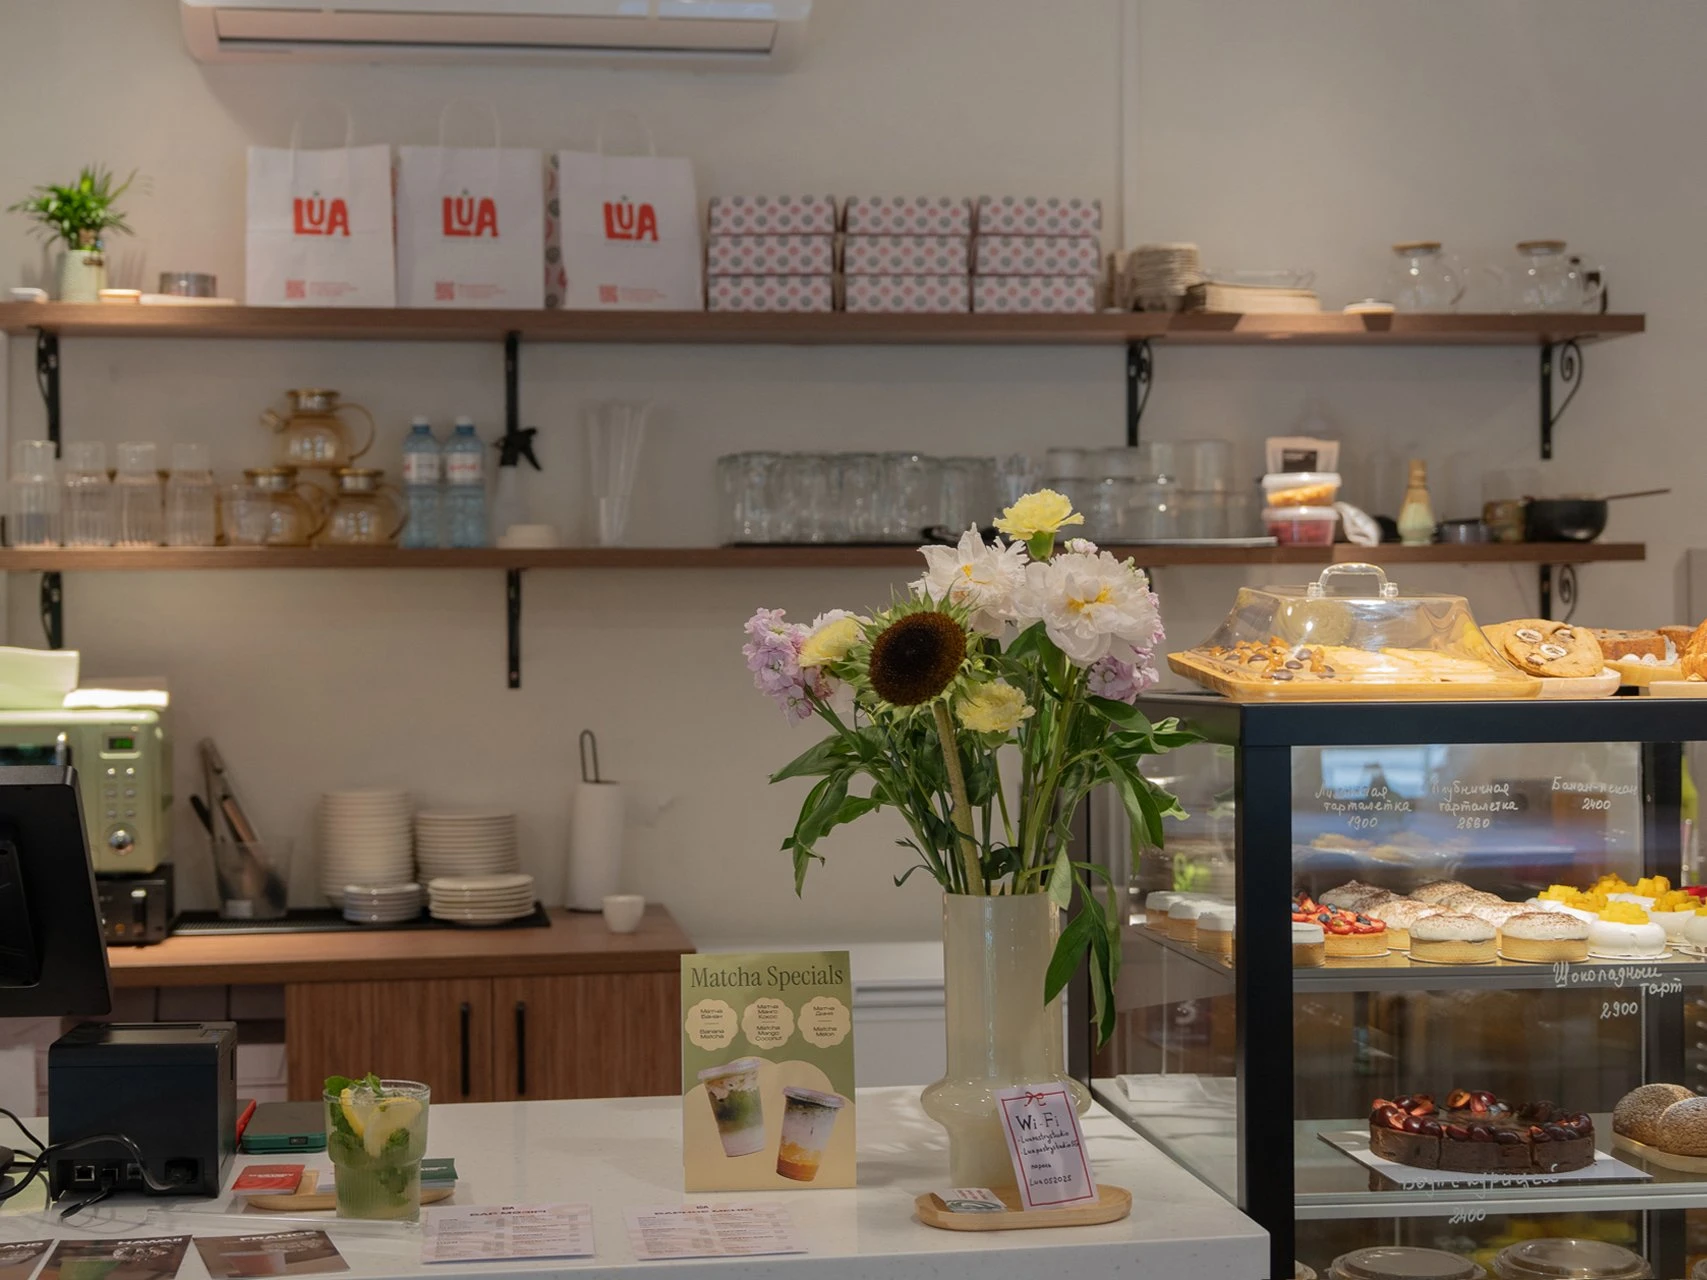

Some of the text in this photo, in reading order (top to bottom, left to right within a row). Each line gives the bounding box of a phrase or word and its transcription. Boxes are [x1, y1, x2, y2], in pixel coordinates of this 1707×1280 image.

[293, 197, 350, 236] LUA
[442, 196, 499, 236] LUA
[603, 201, 659, 242] LUA
[1324, 801, 1412, 816] тарталетка
[1581, 797, 1611, 810] 2400
[1348, 815, 1378, 831] 1900
[691, 965, 843, 991] Matcha Specials
[1600, 1001, 1638, 1019] 2900
[1016, 1112, 1059, 1131] Wi-Fi
[1449, 1206, 1486, 1224] 2400
